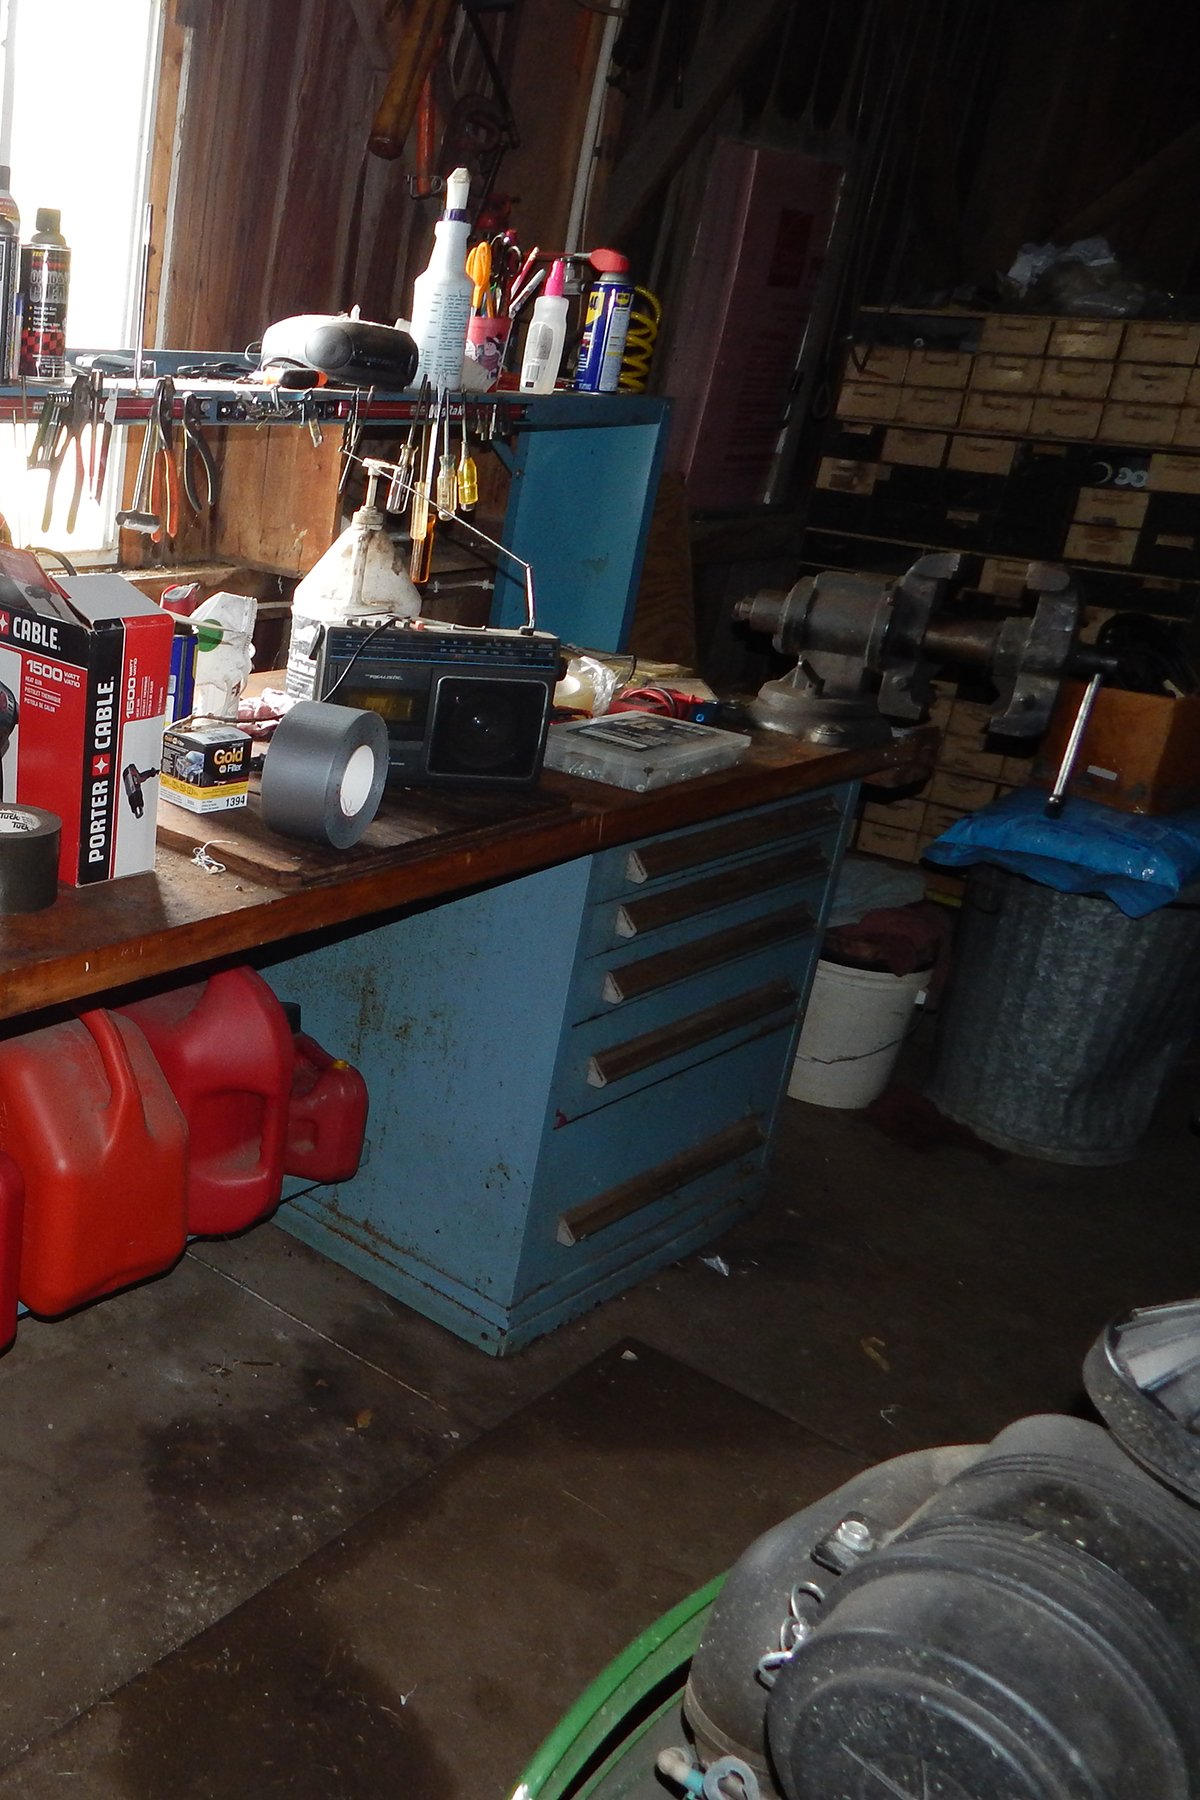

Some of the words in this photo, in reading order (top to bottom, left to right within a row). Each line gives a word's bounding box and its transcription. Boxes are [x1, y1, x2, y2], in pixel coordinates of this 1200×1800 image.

[13, 617, 59, 650] CABLE
[26, 659, 63, 681] 1500
[64, 671, 80, 680] WATT
[126, 677, 136, 719] 1500
[94, 681, 114, 749] CABLE
[214, 747, 244, 766] Gold
[227, 763, 242, 773] Filter
[225, 795, 245, 808] 1394
[88, 780, 109, 863] PORTER
